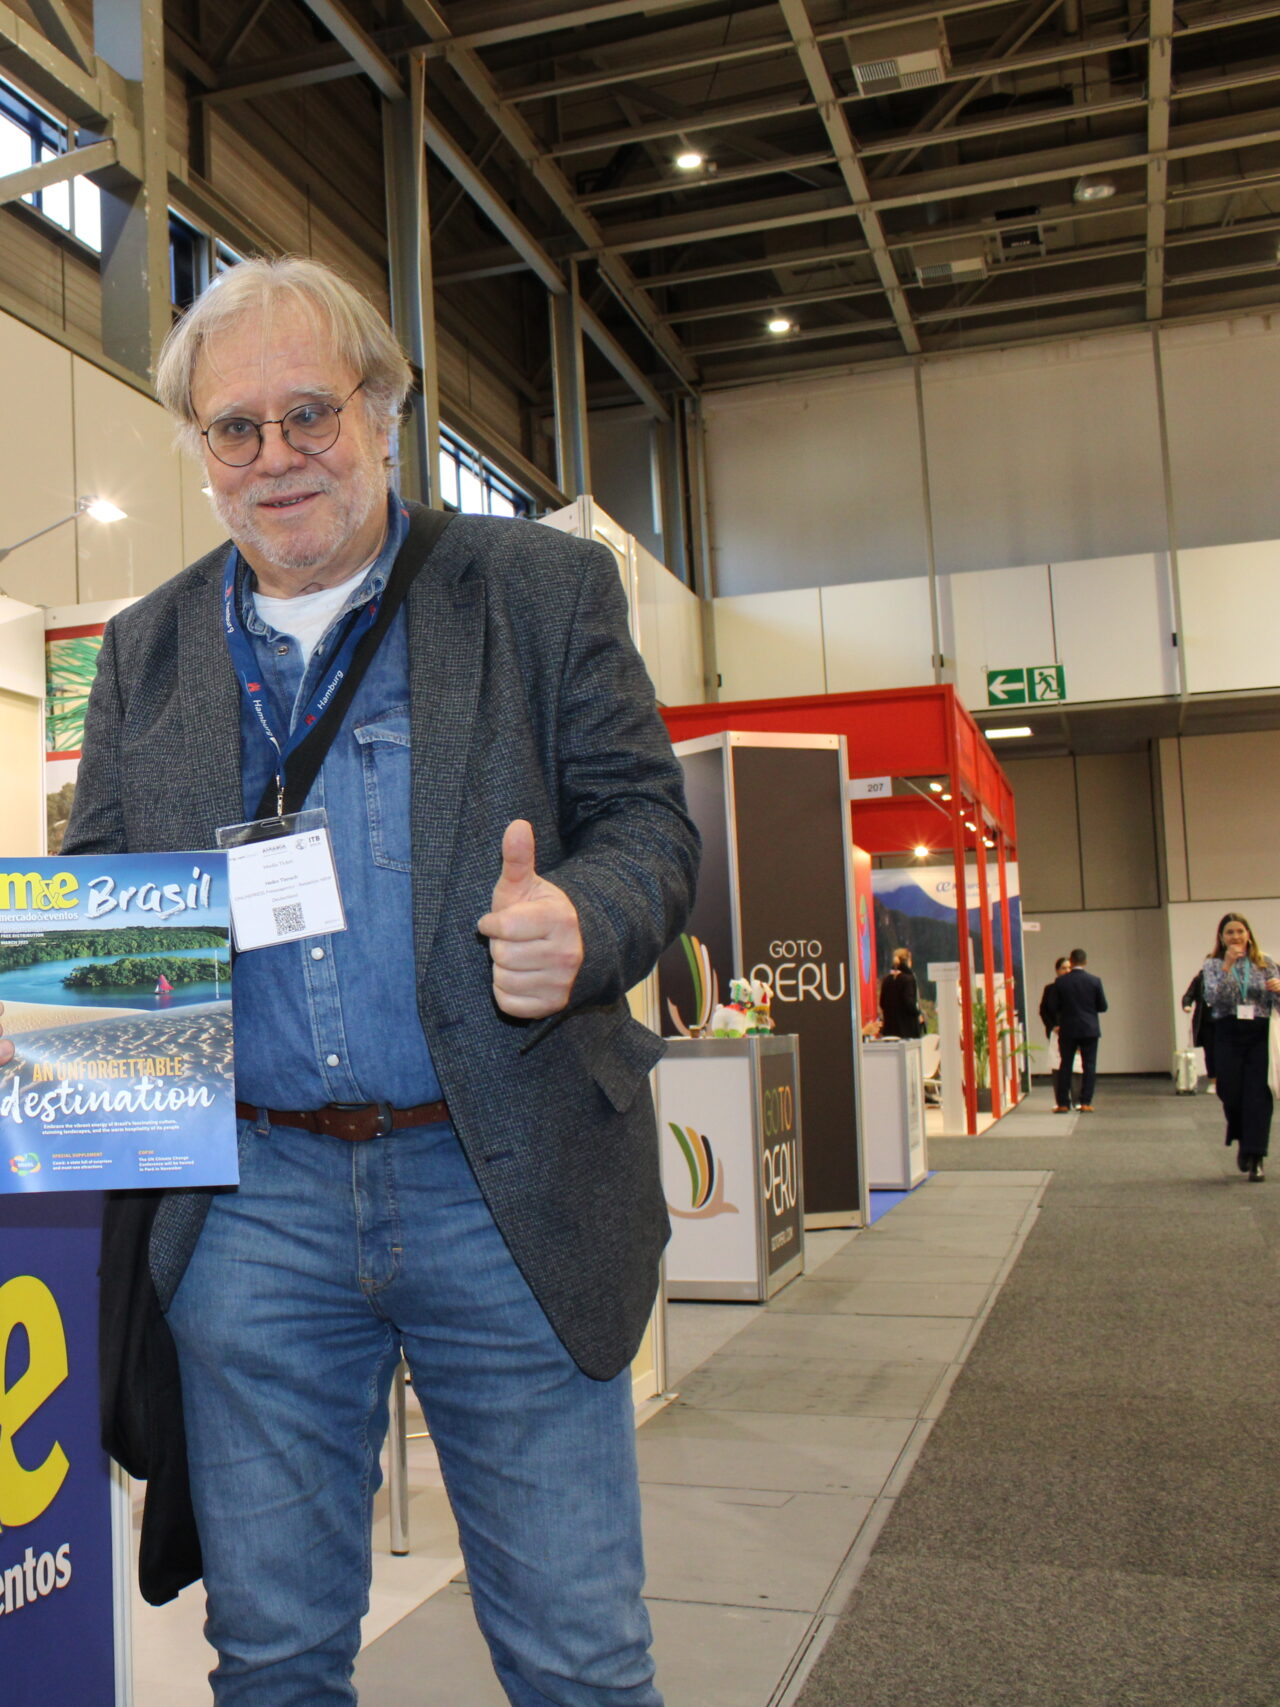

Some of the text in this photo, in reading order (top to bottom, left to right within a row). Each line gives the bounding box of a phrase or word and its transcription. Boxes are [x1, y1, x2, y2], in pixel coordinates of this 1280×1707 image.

[317, 670, 344, 710] Hamburg
[253, 699, 274, 737] Hamburg
[867, 783, 884, 792] 207
[308, 835, 320, 843] ITB
[84, 866, 211, 920] Brasil
[0, 911, 79, 922] mercado&eventos
[750, 962, 845, 1002] PERU
[32, 1057, 184, 1082] AN UNFORGETTABLE
[0, 1075, 215, 1123] destination
[763, 1139, 797, 1216] PERU
